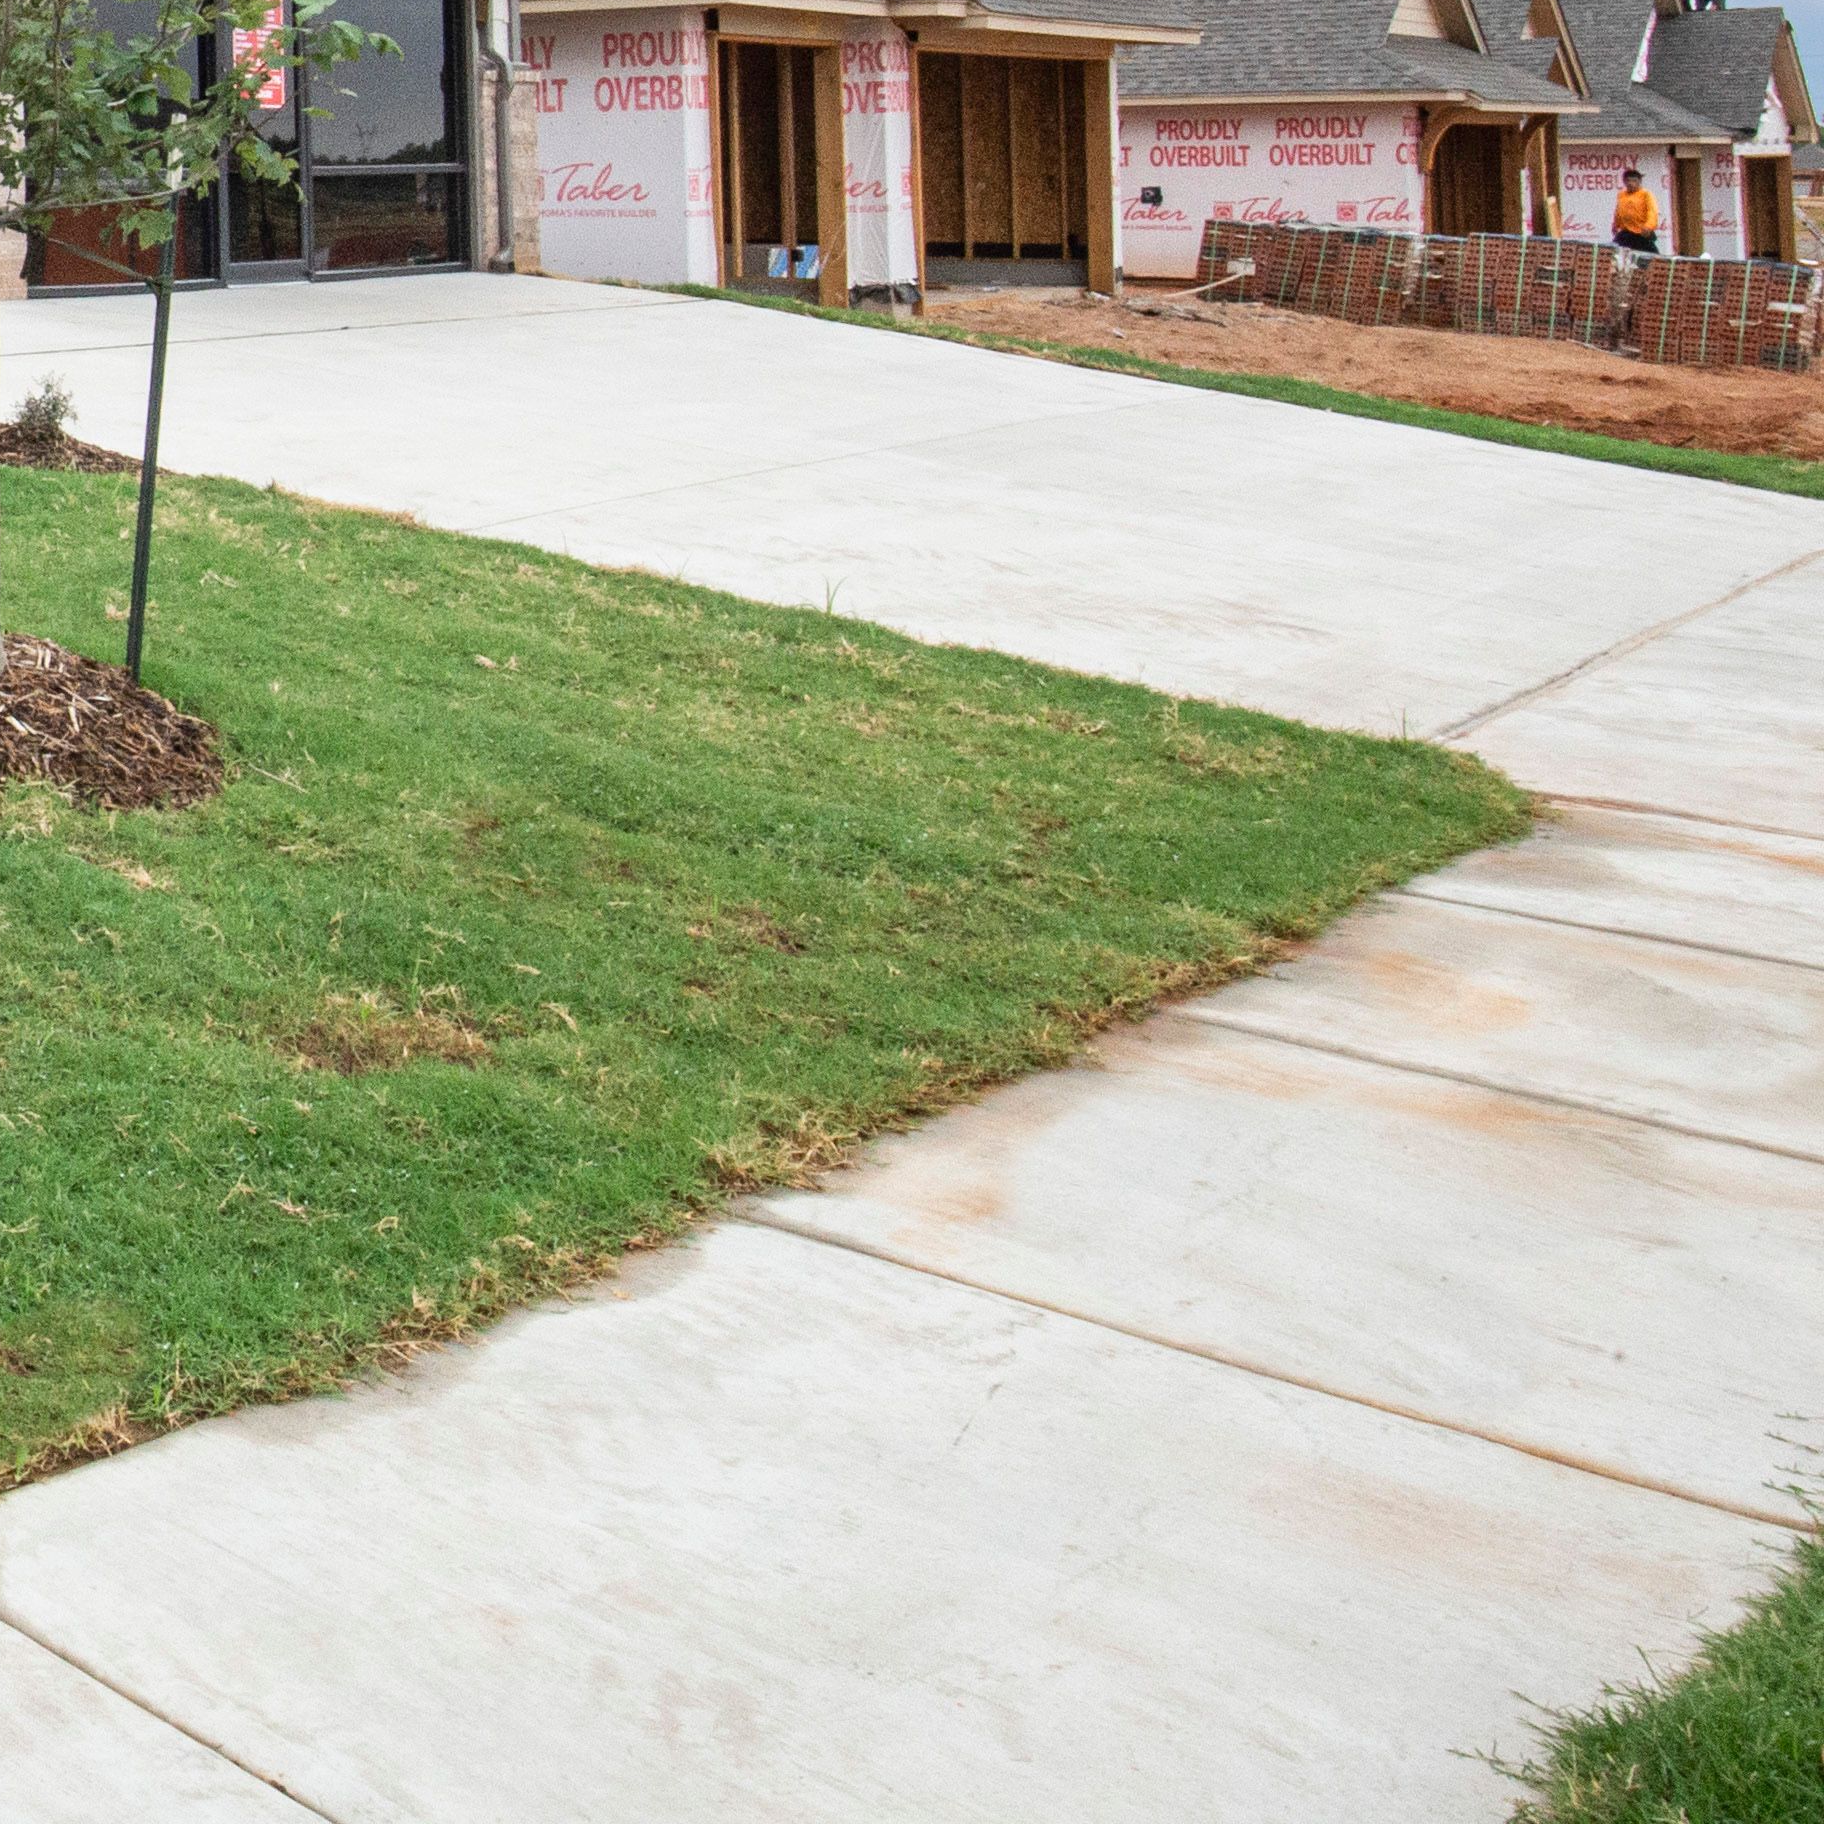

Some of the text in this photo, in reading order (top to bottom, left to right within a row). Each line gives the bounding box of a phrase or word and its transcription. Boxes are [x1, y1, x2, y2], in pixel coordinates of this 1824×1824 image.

[1156, 118, 1243, 141] PROUDLY
[1275, 116, 1368, 139] PROUDLY
[1149, 145, 1250, 167] OVERBUILT
[1269, 143, 1376, 166] OVERBUILT
[552, 162, 650, 202] Taber
